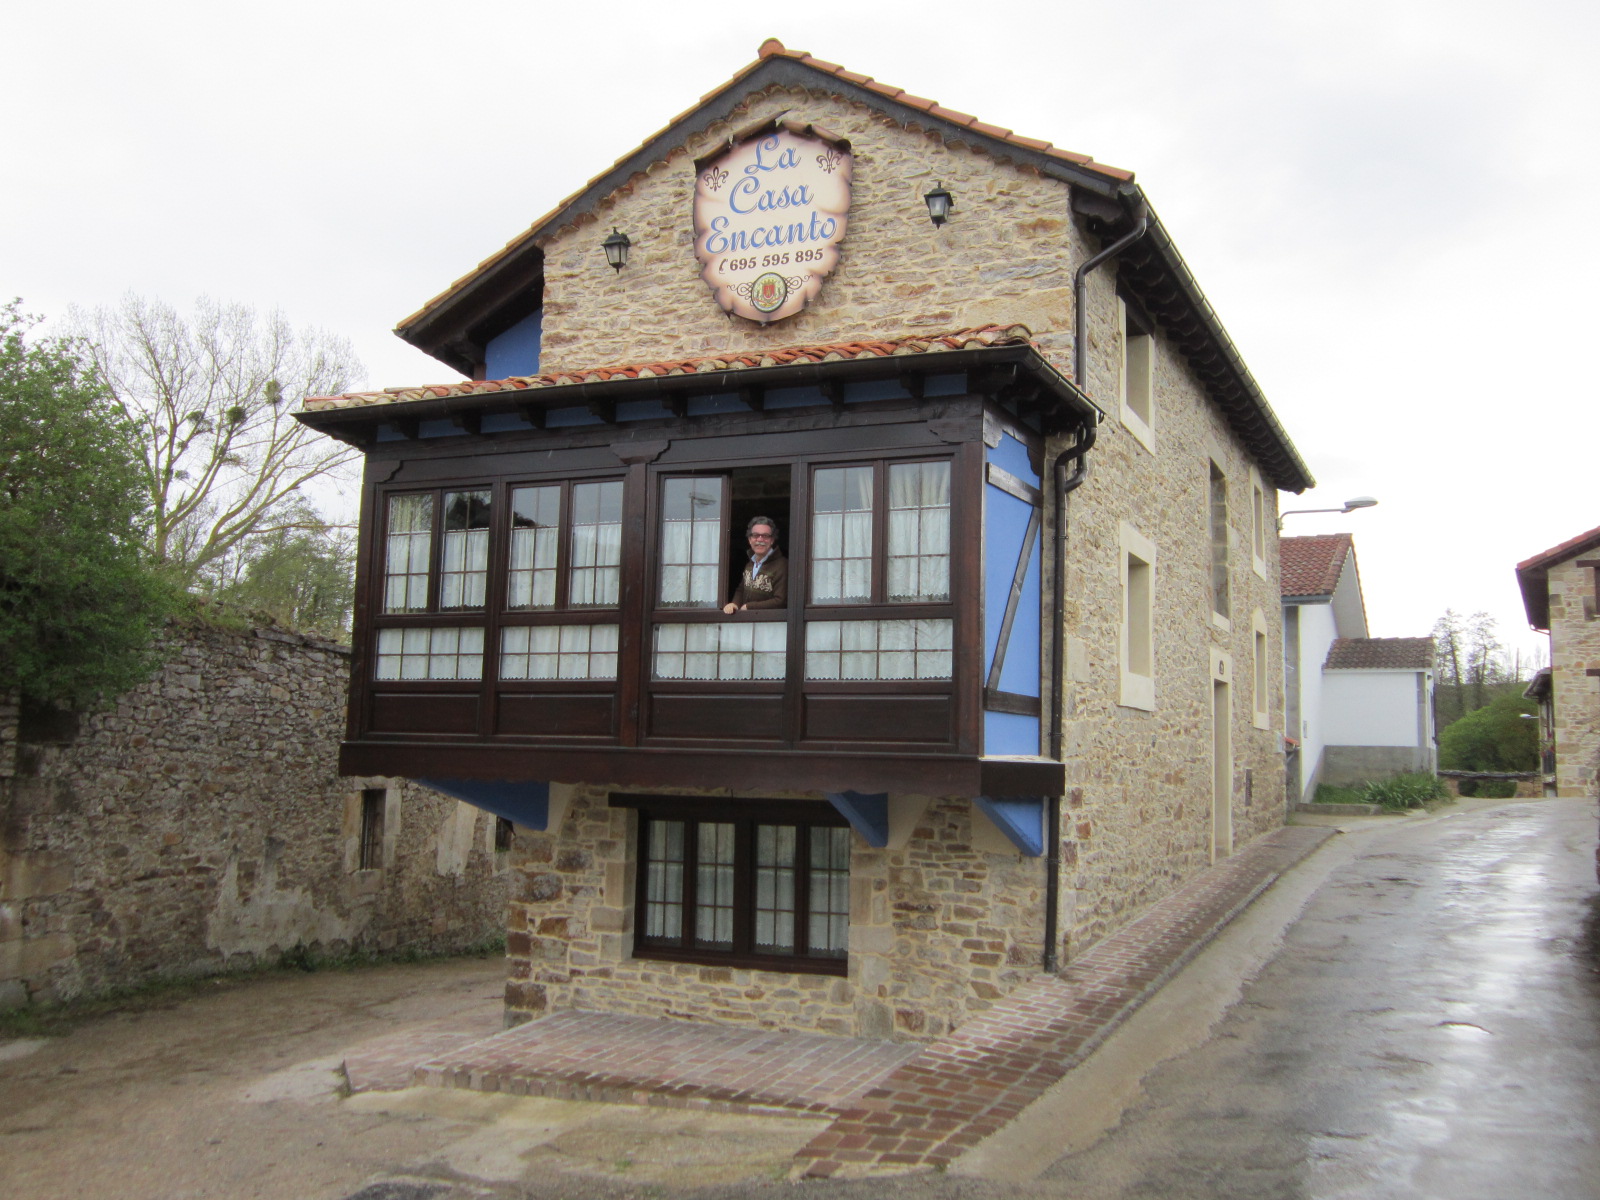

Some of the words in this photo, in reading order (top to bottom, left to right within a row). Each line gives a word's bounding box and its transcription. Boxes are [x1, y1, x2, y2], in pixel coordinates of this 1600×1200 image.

[744, 134, 801, 175] La
[729, 176, 814, 214] Casa
[705, 211, 838, 254] Encanto
[729, 256, 757, 271] 695
[761, 252, 790, 267] 595
[794, 248, 824, 263] 895
